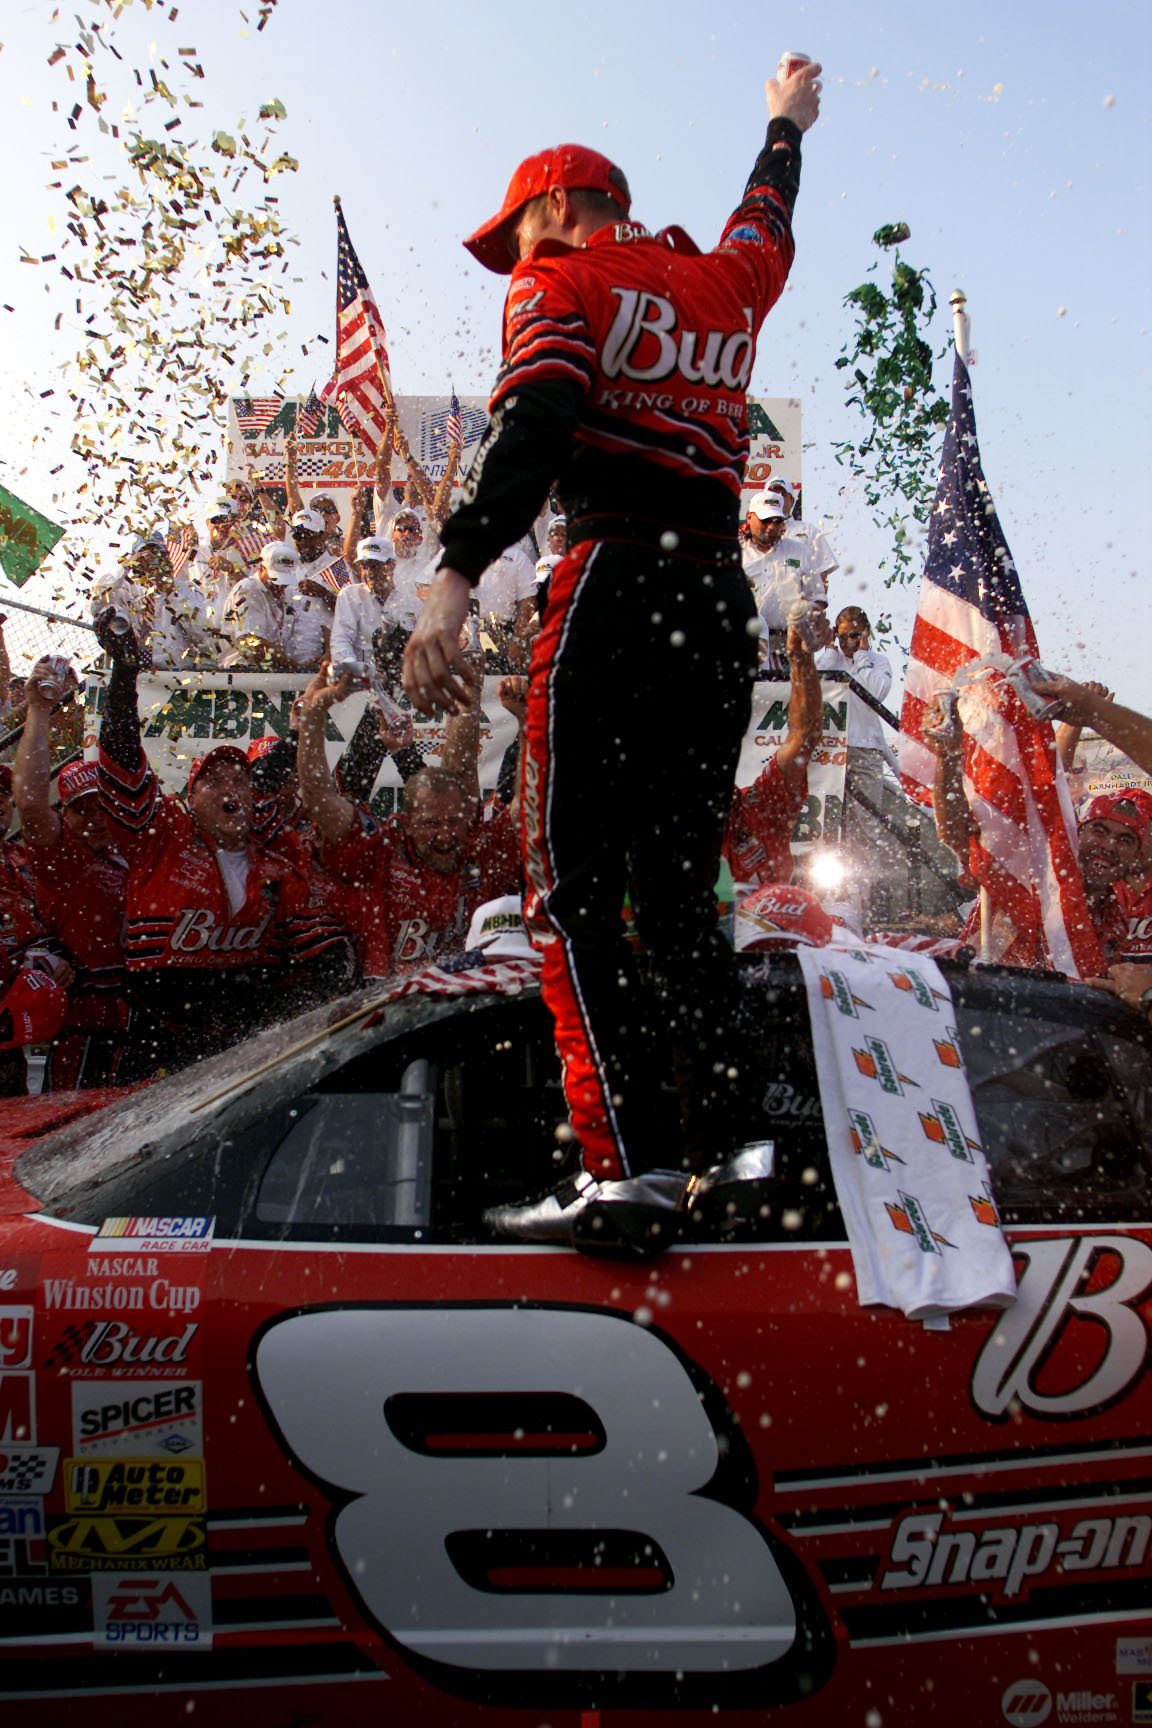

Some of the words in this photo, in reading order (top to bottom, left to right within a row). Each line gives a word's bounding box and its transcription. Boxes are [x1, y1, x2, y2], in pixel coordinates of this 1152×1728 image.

[601, 287, 753, 391] Bud
[601, 389, 673, 410] KING
[681, 399, 710, 415] OF
[754, 896, 808, 915] Bud
[169, 907, 273, 952] Bud
[871, 1040, 899, 1093] Gatorade
[854, 1113, 884, 1169] Gorade
[938, 1104, 967, 1161] Gatorade
[134, 1217, 206, 1238] NASCAR
[140, 1241, 176, 1250] RACE
[181, 1241, 210, 1250] CAR
[86, 1258, 159, 1277] NASCAR
[43, 1279, 146, 1311] Winston
[149, 1278, 201, 1314] Cup
[80, 1320, 200, 1365] Bud
[111, 1366, 189, 1377] WINNER
[81, 1385, 196, 1435] SPICER
[108, 1463, 185, 1484] Auto
[256, 1309, 798, 1672] 8
[106, 1485, 200, 1506] Meter
[151, 1551, 207, 1570] WEAR
[880, 1512, 1151, 1596] Snap-on
[107, 1580, 198, 1621] EA
[105, 1621, 200, 1642] SPORTS
